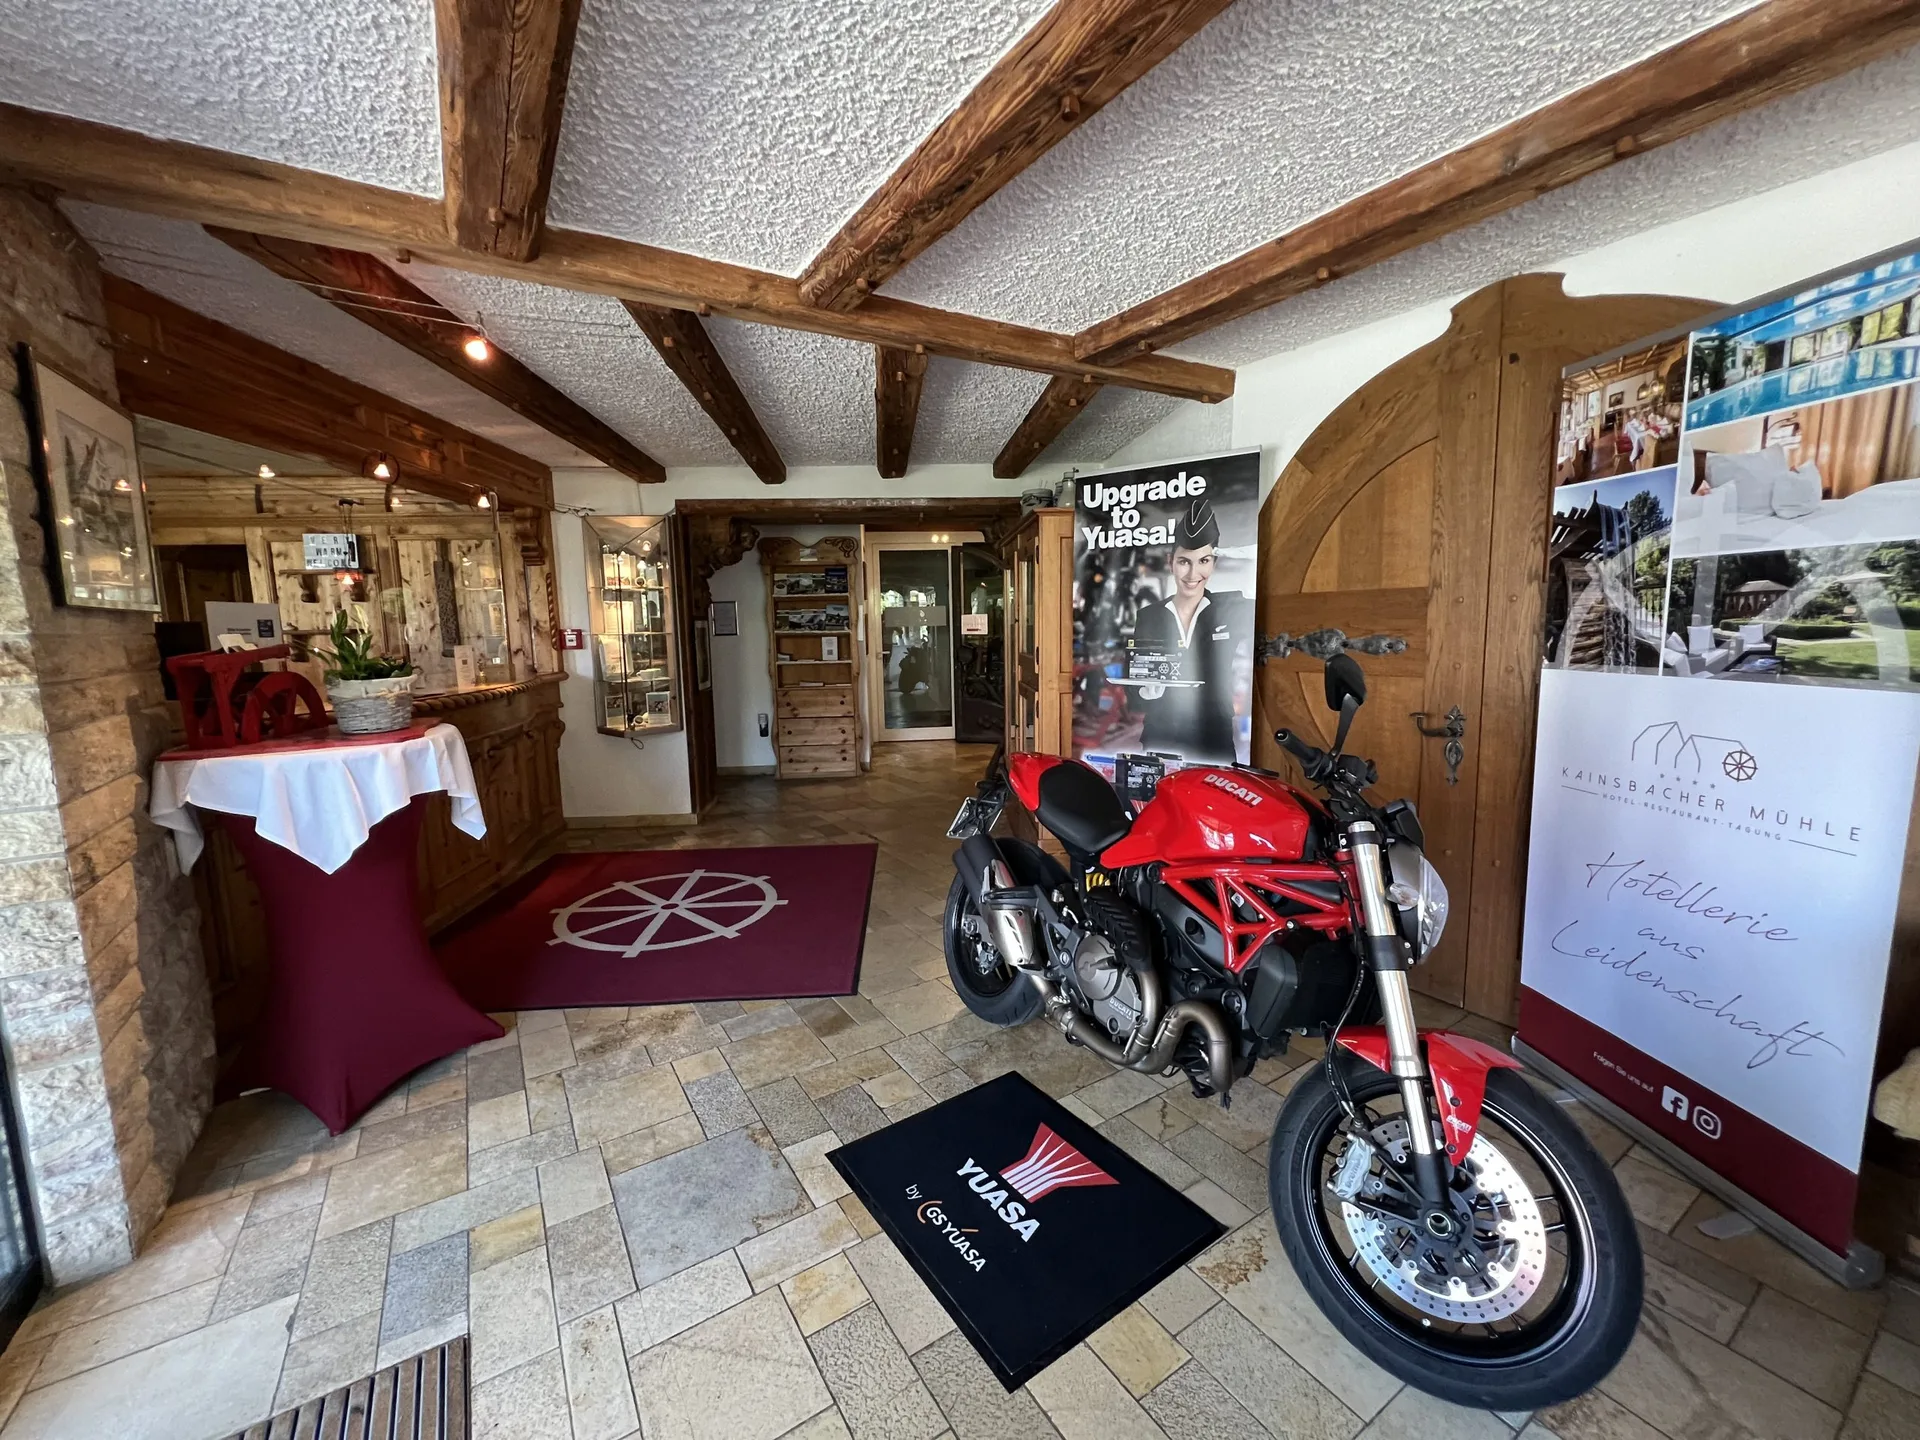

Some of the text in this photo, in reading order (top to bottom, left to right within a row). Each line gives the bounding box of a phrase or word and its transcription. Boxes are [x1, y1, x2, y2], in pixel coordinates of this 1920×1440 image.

[1083, 471, 1207, 512] Upgrade
[1081, 518, 1176, 550] Yuasa!
[1110, 505, 1141, 529] to
[1203, 773, 1263, 806] DUCATI
[1562, 766, 1861, 842] KAINSBACHER MÜHLE
[1586, 851, 1799, 941] Hotellerie
[1637, 927, 1705, 960] aus
[1109, 998, 1132, 1016] DUCATI
[1551, 919, 1846, 1069] Leidenschaft
[1593, 1051, 1615, 1069] Folgen
[1615, 1065, 1627, 1077] Sie
[1627, 1074, 1641, 1086] uns
[905, 1183, 923, 1200] by
[956, 1157, 1040, 1243] YUASA
